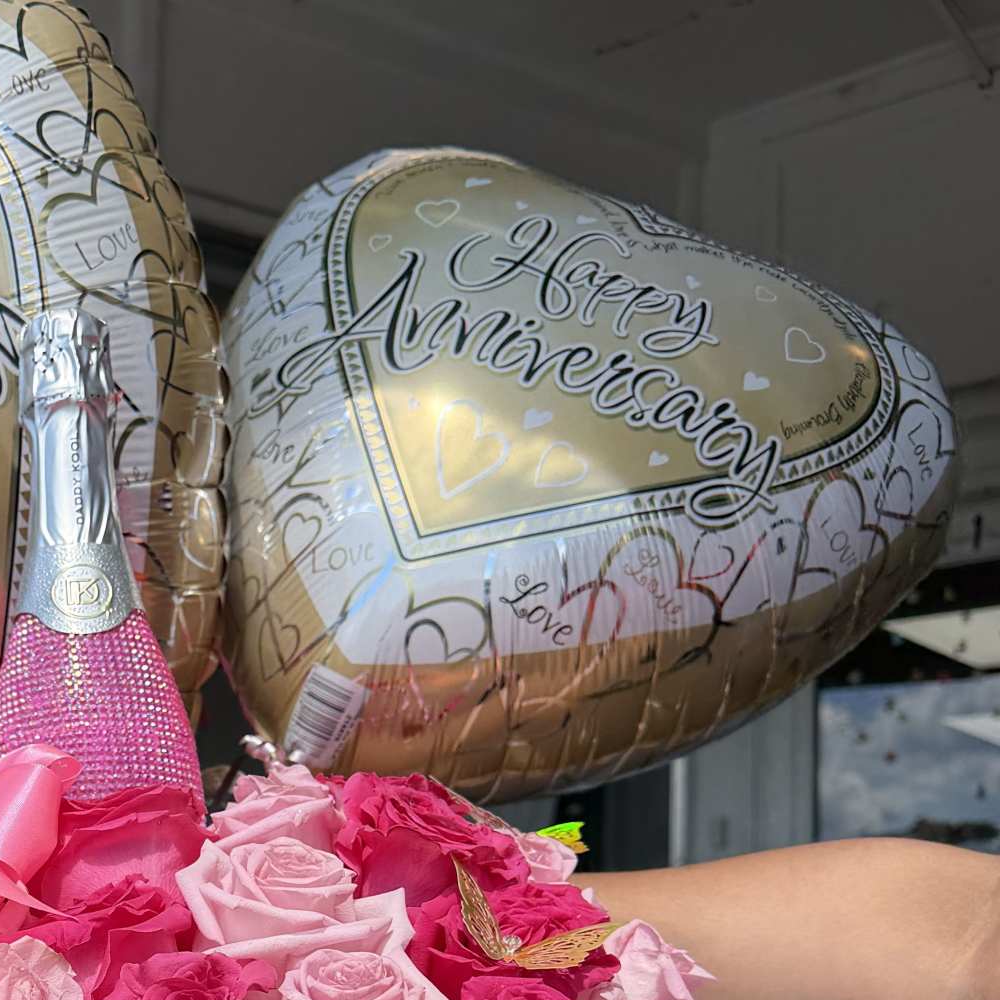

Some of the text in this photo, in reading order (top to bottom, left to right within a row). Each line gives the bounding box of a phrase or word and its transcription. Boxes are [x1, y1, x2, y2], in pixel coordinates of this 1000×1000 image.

[448, 216, 719, 356] Happy
[248, 250, 778, 526] Anniversary
[73, 478, 85, 526] DADDY
[499, 574, 573, 646] Love
